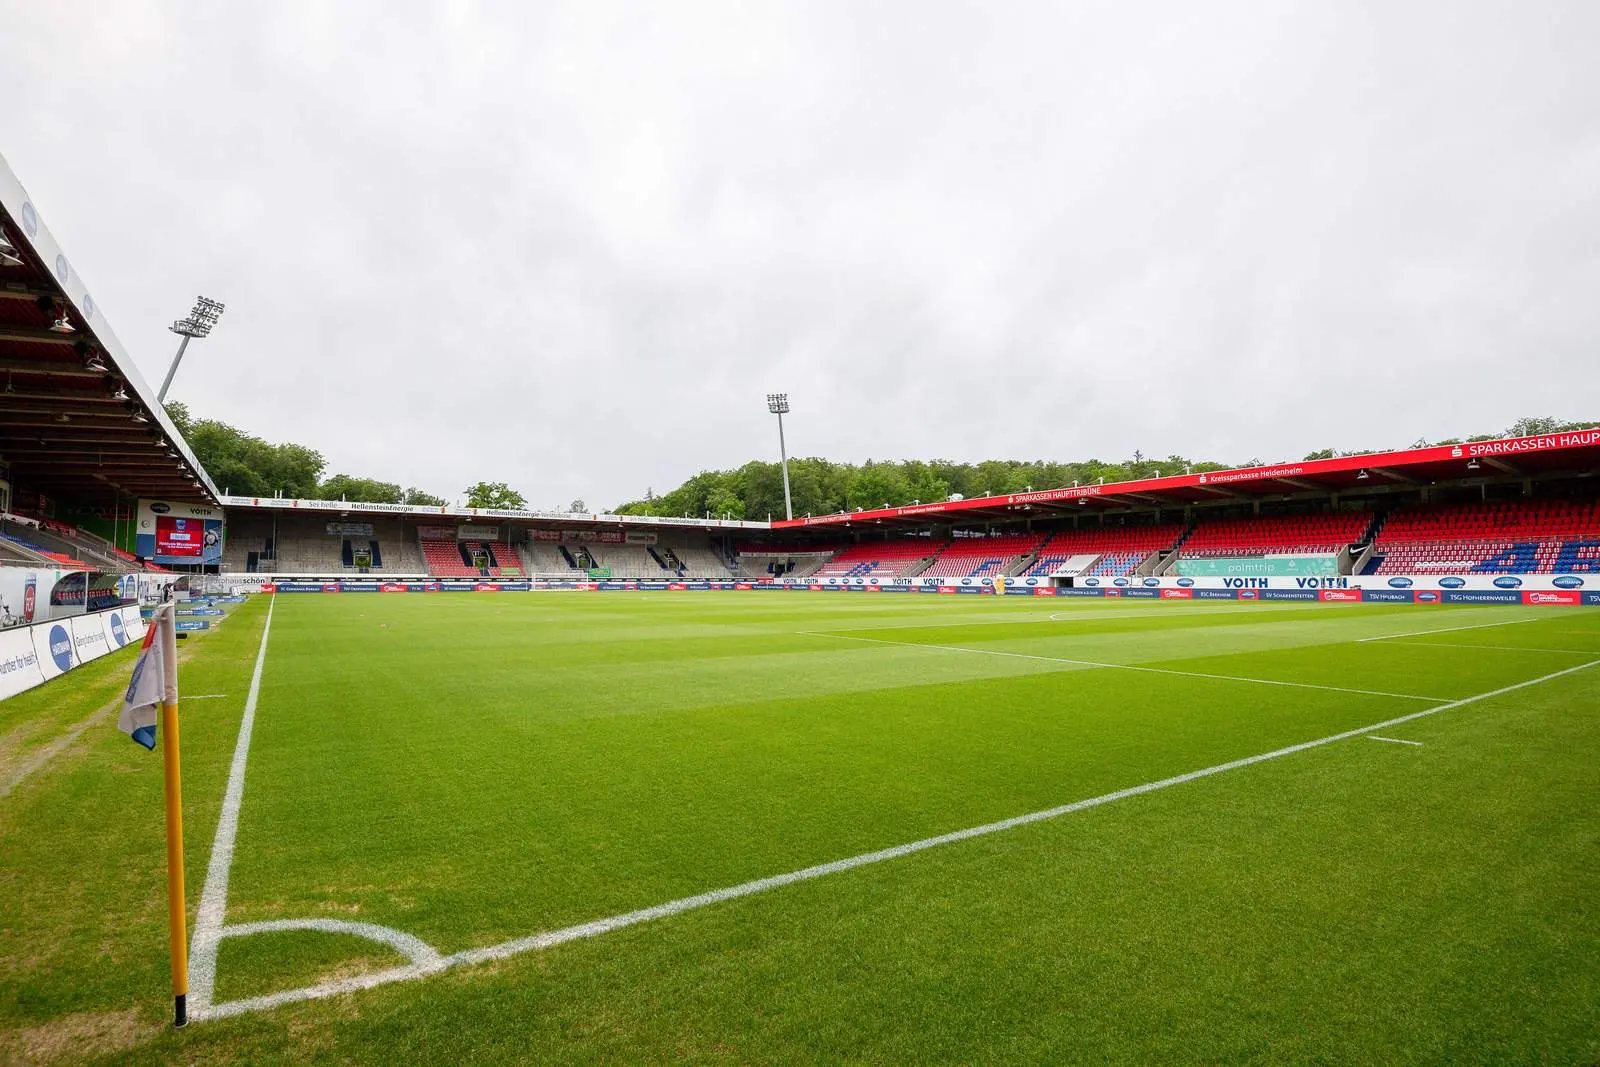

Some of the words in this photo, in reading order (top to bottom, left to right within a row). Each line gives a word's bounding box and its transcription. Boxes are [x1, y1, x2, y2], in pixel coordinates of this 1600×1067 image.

[1469, 437, 1555, 456] SPARKASSEN
[1210, 472, 1259, 483] Kreissparkasse
[1260, 467, 1303, 477] Heidenheim
[1015, 492, 1052, 503] SPARKASSEN
[1228, 562, 1276, 573] palmtrip
[1222, 577, 1269, 588] VOITH
[1295, 577, 1348, 589] VOITH
